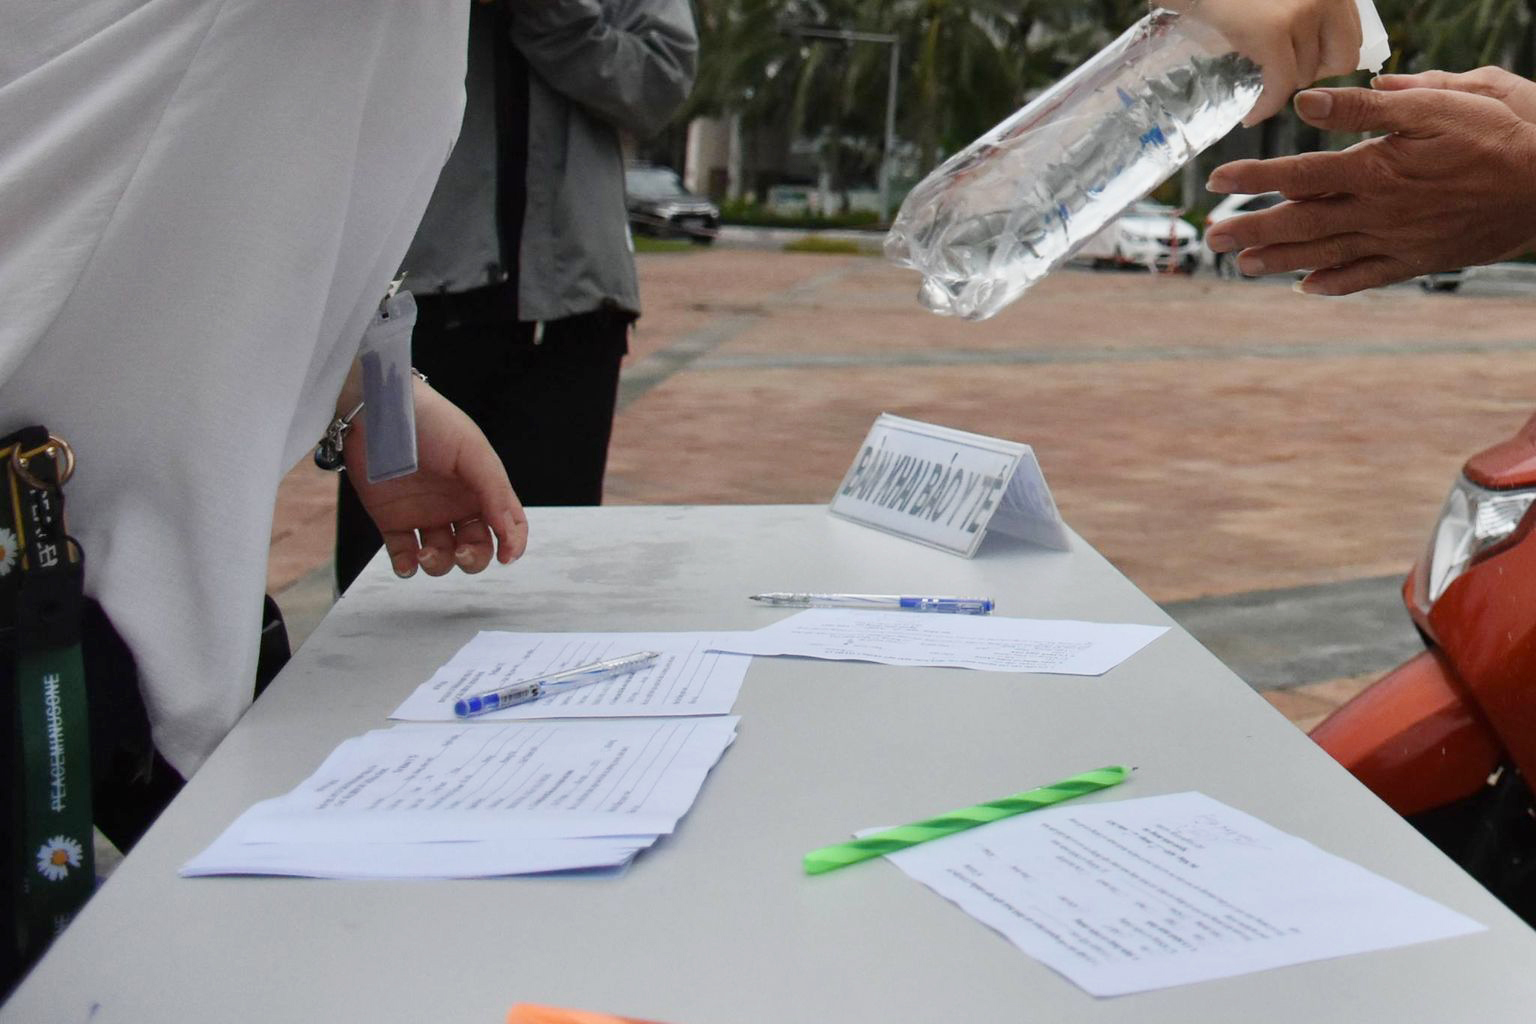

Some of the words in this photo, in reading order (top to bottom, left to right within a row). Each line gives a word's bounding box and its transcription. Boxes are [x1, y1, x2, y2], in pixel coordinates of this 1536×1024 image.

[872, 453, 932, 513] KHAI
[909, 452, 964, 522] BÁO
[946, 471, 981, 527] Y
